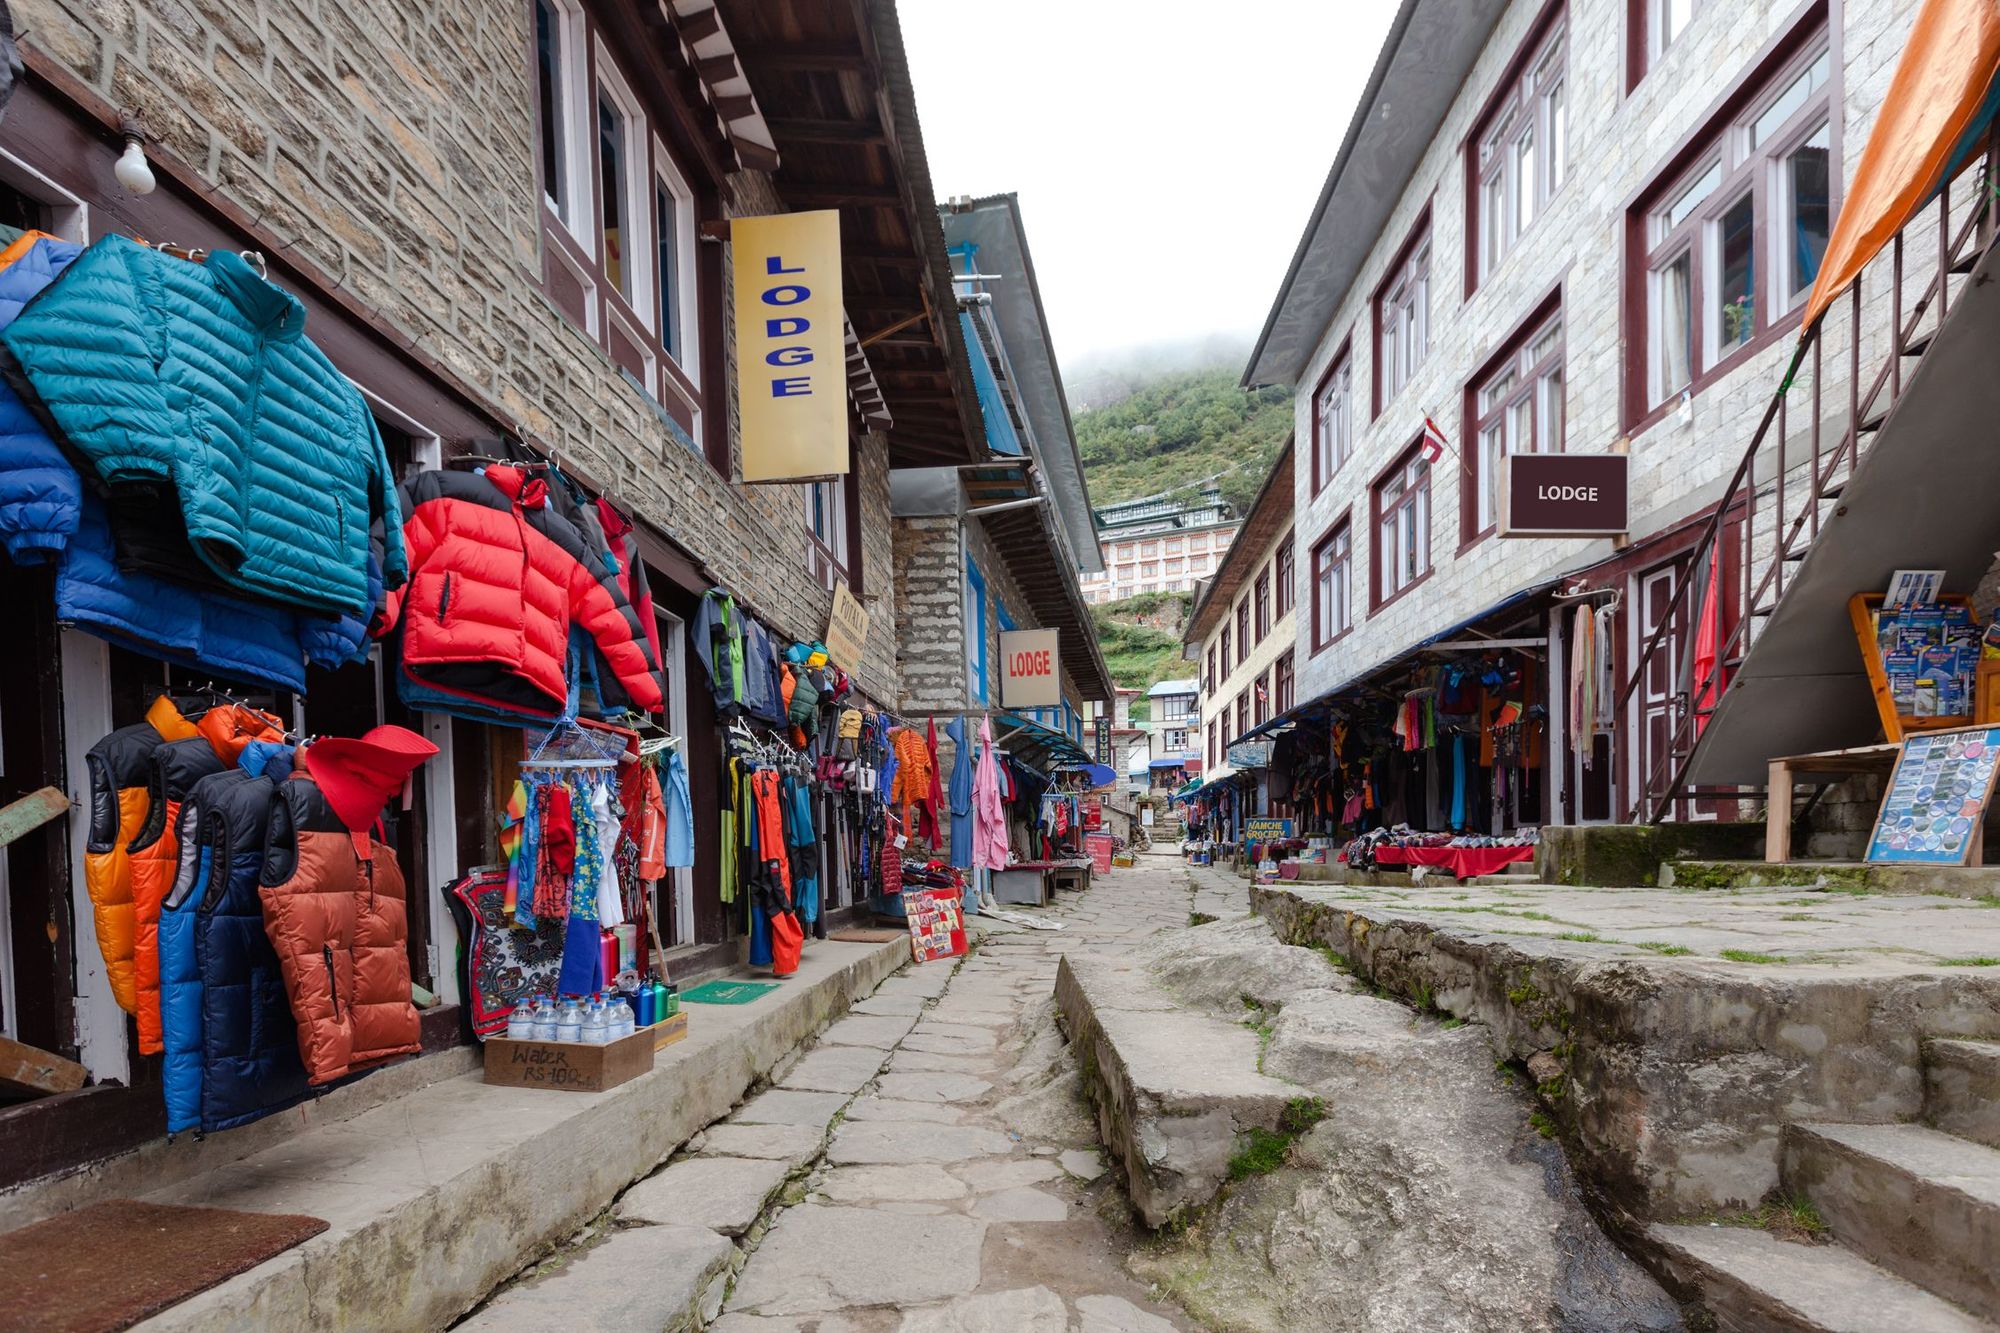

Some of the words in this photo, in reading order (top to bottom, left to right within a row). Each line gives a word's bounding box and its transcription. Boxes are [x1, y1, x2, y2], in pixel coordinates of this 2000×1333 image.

[761, 256, 814, 398] LODGE
[1538, 485, 1598, 502] LODGE
[840, 595, 864, 635] POTALA
[1009, 649, 1051, 677] LODGE
[1099, 723, 1109, 763] KHUMBU
[1932, 735, 1956, 746] Fridge
[1957, 730, 1986, 742] Magnet
[1247, 821, 1283, 830] NAMCHE
[1247, 830, 1286, 839] GROCERY
